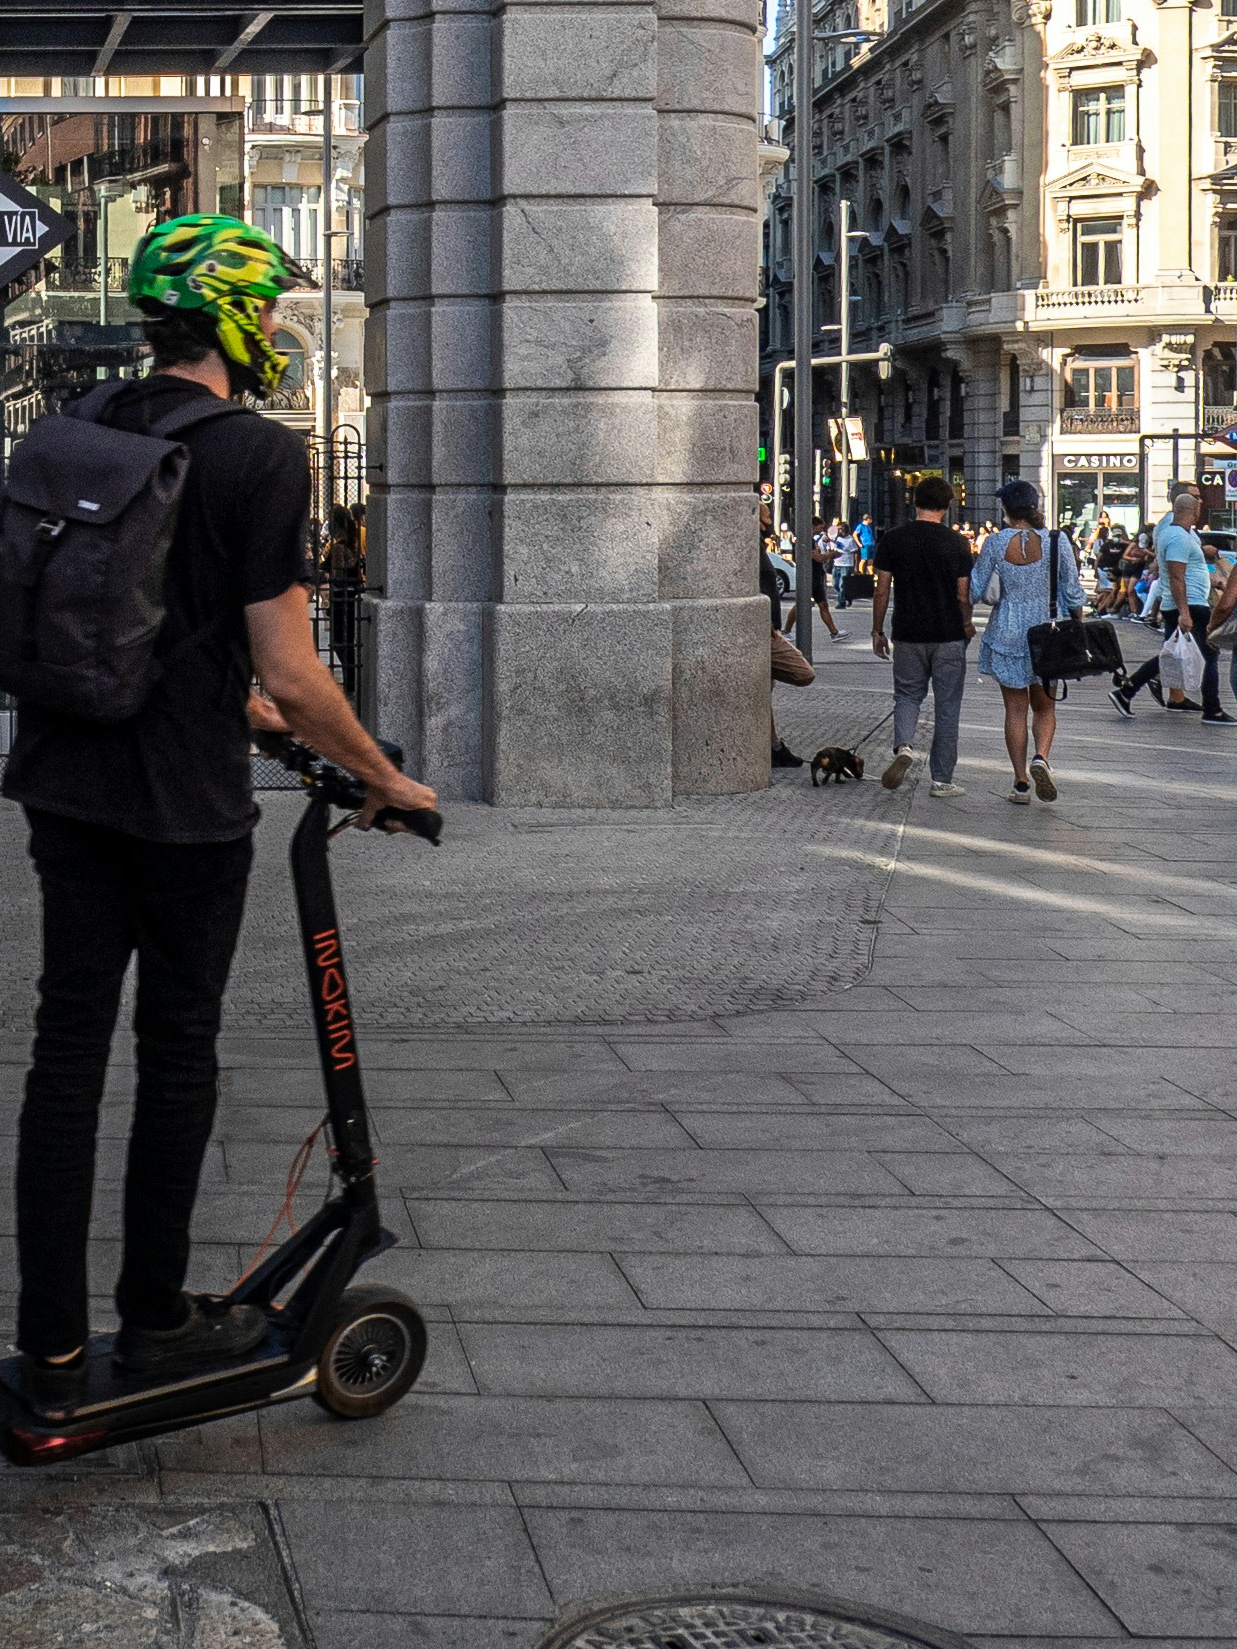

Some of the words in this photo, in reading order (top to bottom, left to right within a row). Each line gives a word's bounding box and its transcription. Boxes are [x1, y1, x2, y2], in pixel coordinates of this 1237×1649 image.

[4, 209, 34, 243] VÍA
[1063, 455, 1137, 468] CASINO
[313, 928, 356, 1071] INOKIM
